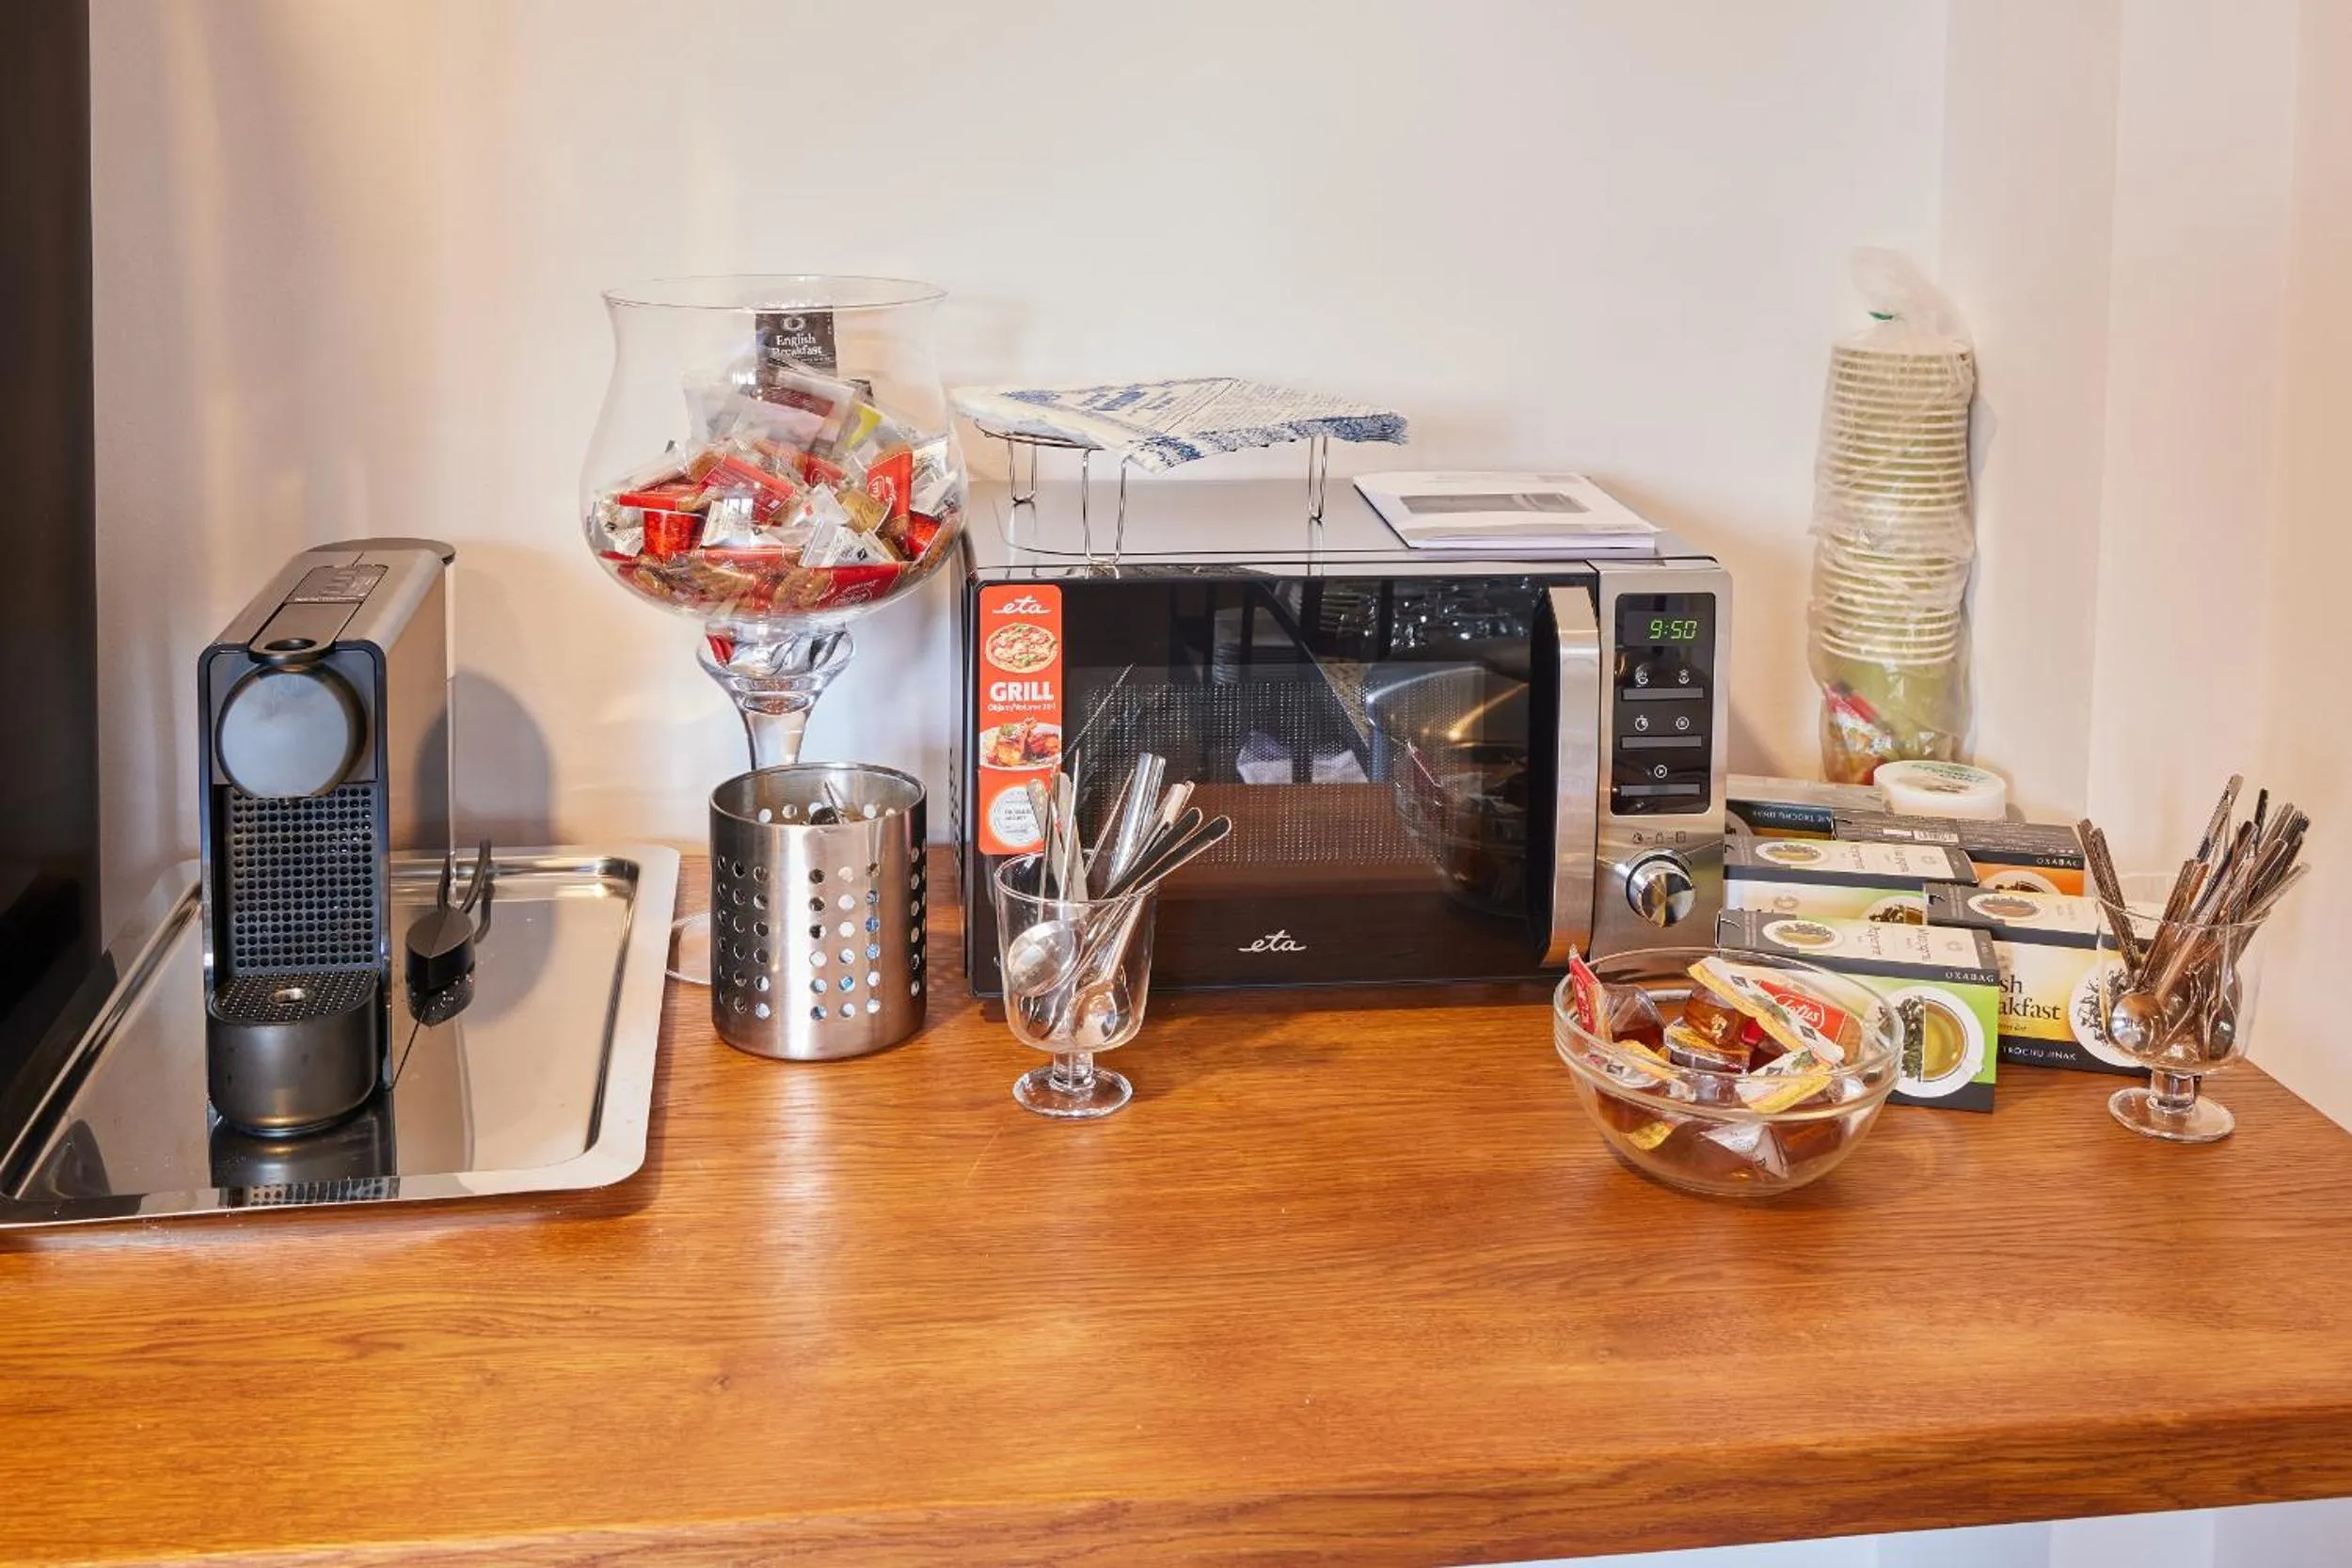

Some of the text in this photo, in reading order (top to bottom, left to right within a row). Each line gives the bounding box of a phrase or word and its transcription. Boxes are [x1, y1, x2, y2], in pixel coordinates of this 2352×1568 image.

[775, 333, 817, 346] English
[771, 344, 822, 356] Breakfast
[993, 594, 1053, 614] eta
[1649, 620, 1697, 639] 9:50
[990, 681, 1055, 702] GRILL
[1238, 929, 1307, 953] eta
[1945, 972, 1994, 983] OXABAG
[1998, 996, 2061, 1021] akfast
[2002, 1046, 2044, 1058] TROCHU
